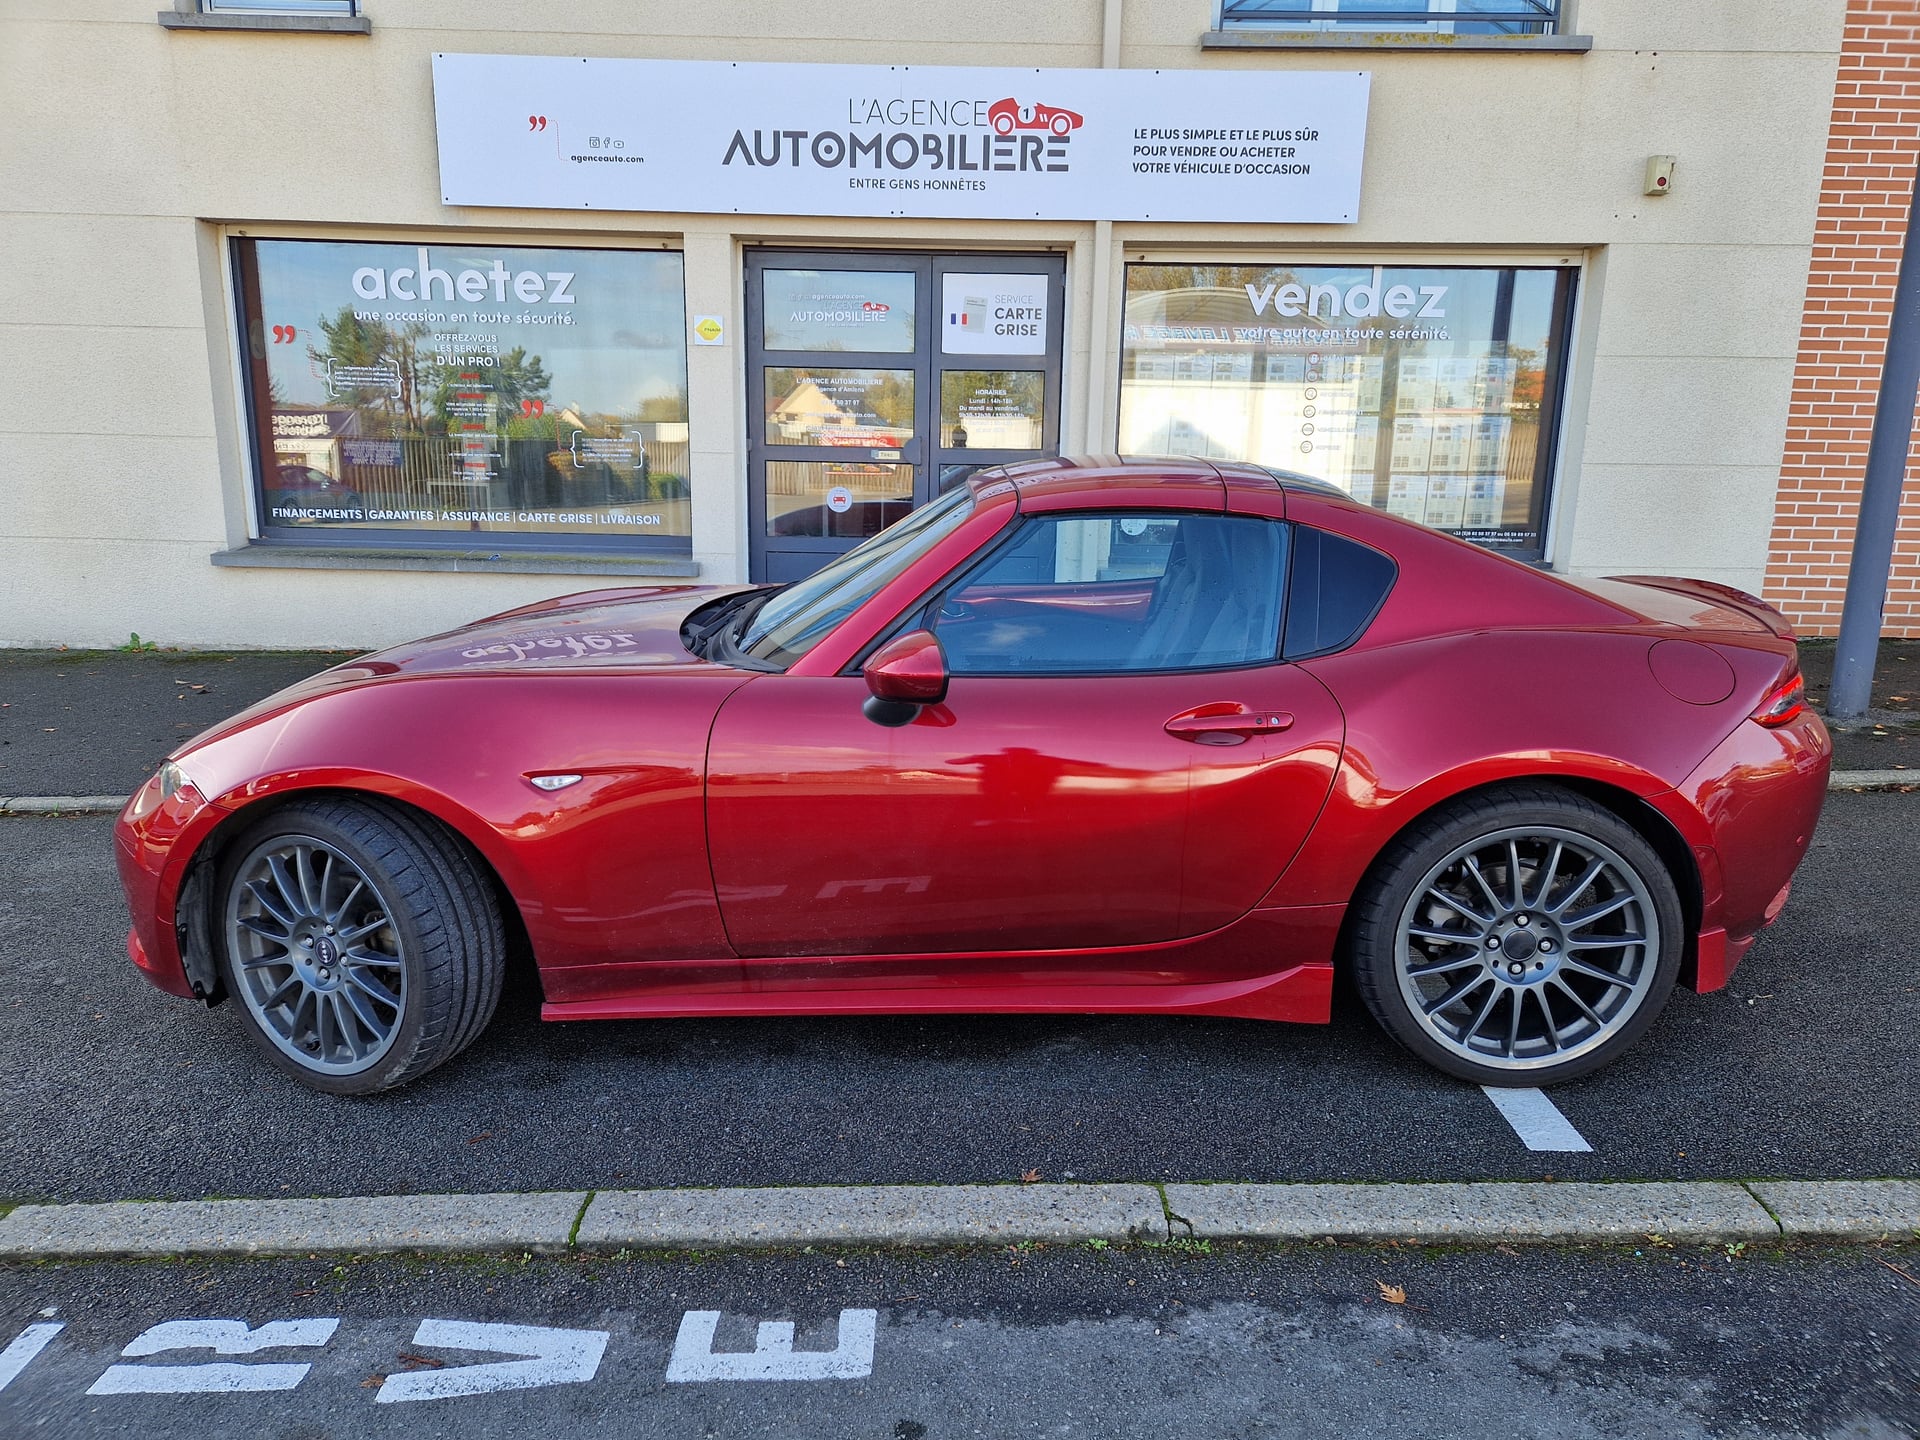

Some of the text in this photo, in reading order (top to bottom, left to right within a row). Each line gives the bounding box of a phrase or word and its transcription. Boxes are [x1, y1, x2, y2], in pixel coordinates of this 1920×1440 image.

[849, 98, 988, 126] L'AGENCE
[1134, 127, 1319, 141] LE PLUS SIMPLE ET LE PLUS SÛR
[571, 153, 644, 164] agenceauto.com
[1133, 146, 1296, 158] POUR VENDRE OU ACHETER
[1132, 160, 1310, 175] VOTRE VÉHICULE D'OCCASION
[849, 178, 986, 191] ENTRE GENS HONNÊTES
[352, 247, 577, 304] achetez
[1244, 265, 1449, 318] vendez
[995, 295, 1033, 304] SERVICE
[354, 309, 577, 325] une occasion en toute sécurité.
[994, 308, 1042, 320] CARTE
[994, 324, 1037, 336] GRISE
[1240, 327, 1277, 339] votre
[1283, 327, 1317, 339] auto
[1321, 329, 1340, 339] en
[1344, 327, 1384, 340] toute
[1389, 325, 1451, 340] sérénité.
[434, 333, 497, 343] OFFREZ-VOUS
[434, 345, 498, 354] LES SERVICES
[437, 356, 465, 366] D'UN
[468, 357, 494, 367] PRO
[272, 508, 362, 520] FINANCEMENTS
[369, 510, 434, 521] GARANTIES
[441, 511, 510, 522] ASSURANCE
[519, 512, 556, 523] CARTE
[558, 513, 593, 523] GRISE
[601, 514, 660, 525] LIVRAISON
